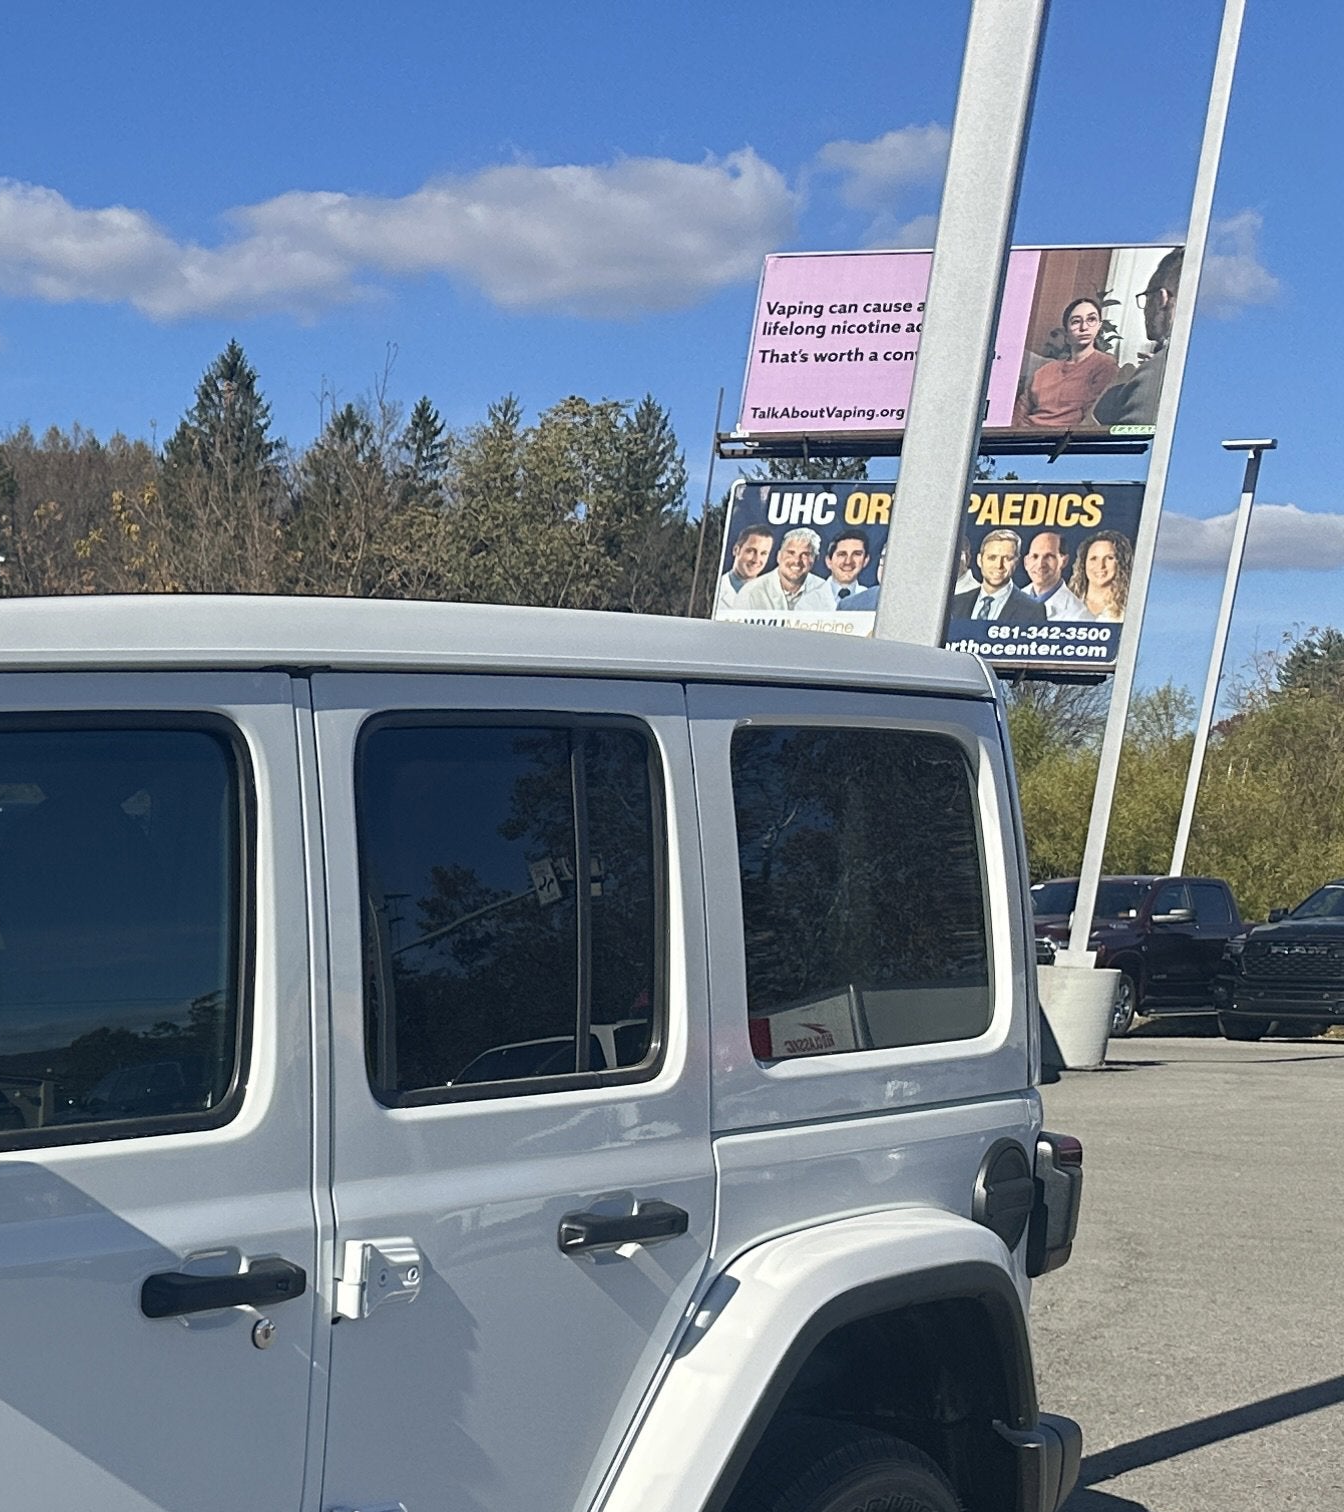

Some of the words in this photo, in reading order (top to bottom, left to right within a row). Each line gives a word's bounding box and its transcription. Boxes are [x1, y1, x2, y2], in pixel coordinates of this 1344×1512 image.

[766, 301, 824, 318] Vaping
[829, 302, 858, 314] can
[863, 302, 912, 313] cause
[762, 321, 826, 338] lifelong
[831, 320, 901, 335] nicotine
[759, 349, 809, 363] That's
[814, 348, 864, 362] worth
[868, 351, 878, 362] a
[751, 406, 905, 421] TalkAboutVaping.org
[767, 492, 837, 526] UHC
[988, 626, 1111, 640] 681-342-3500
